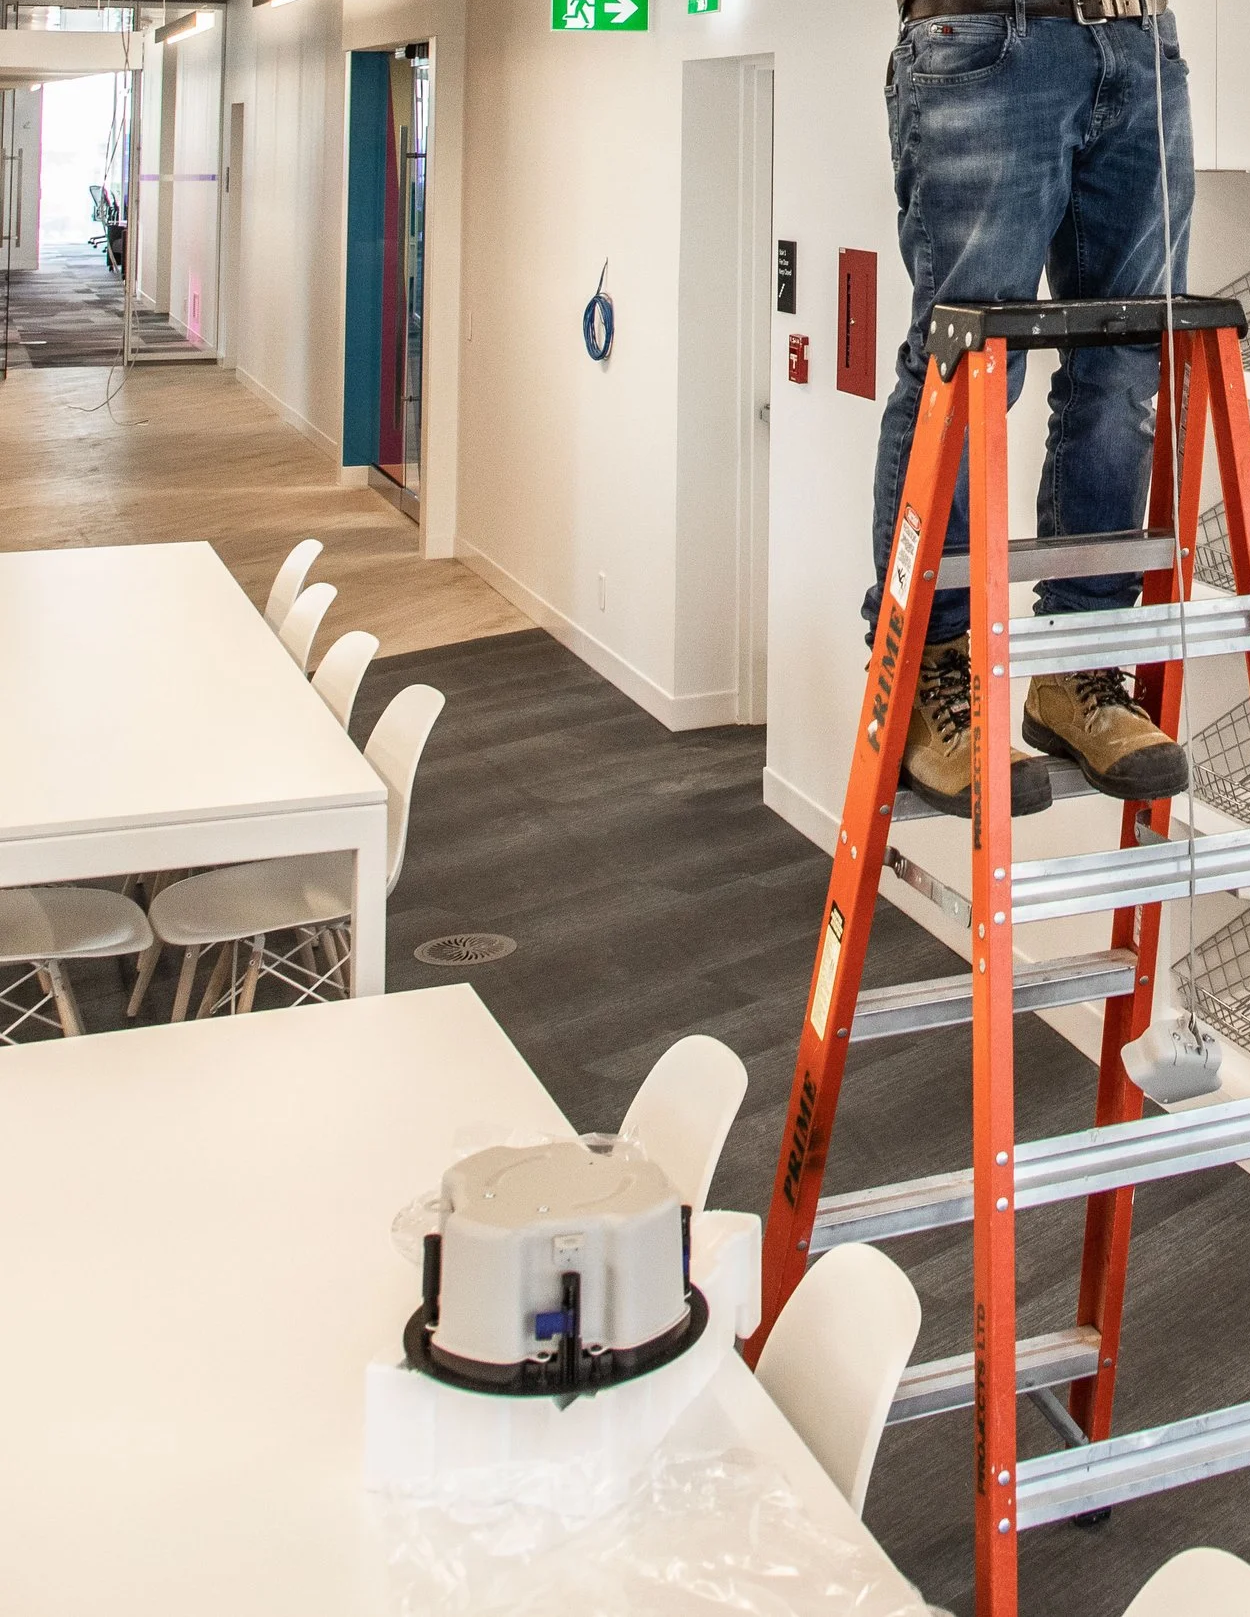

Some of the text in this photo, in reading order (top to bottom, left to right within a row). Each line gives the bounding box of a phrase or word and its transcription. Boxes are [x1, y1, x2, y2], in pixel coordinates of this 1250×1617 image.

[973, 674, 981, 718] LTD
[783, 1069, 818, 1211] PRIME
[976, 1303, 986, 1352] LTD
